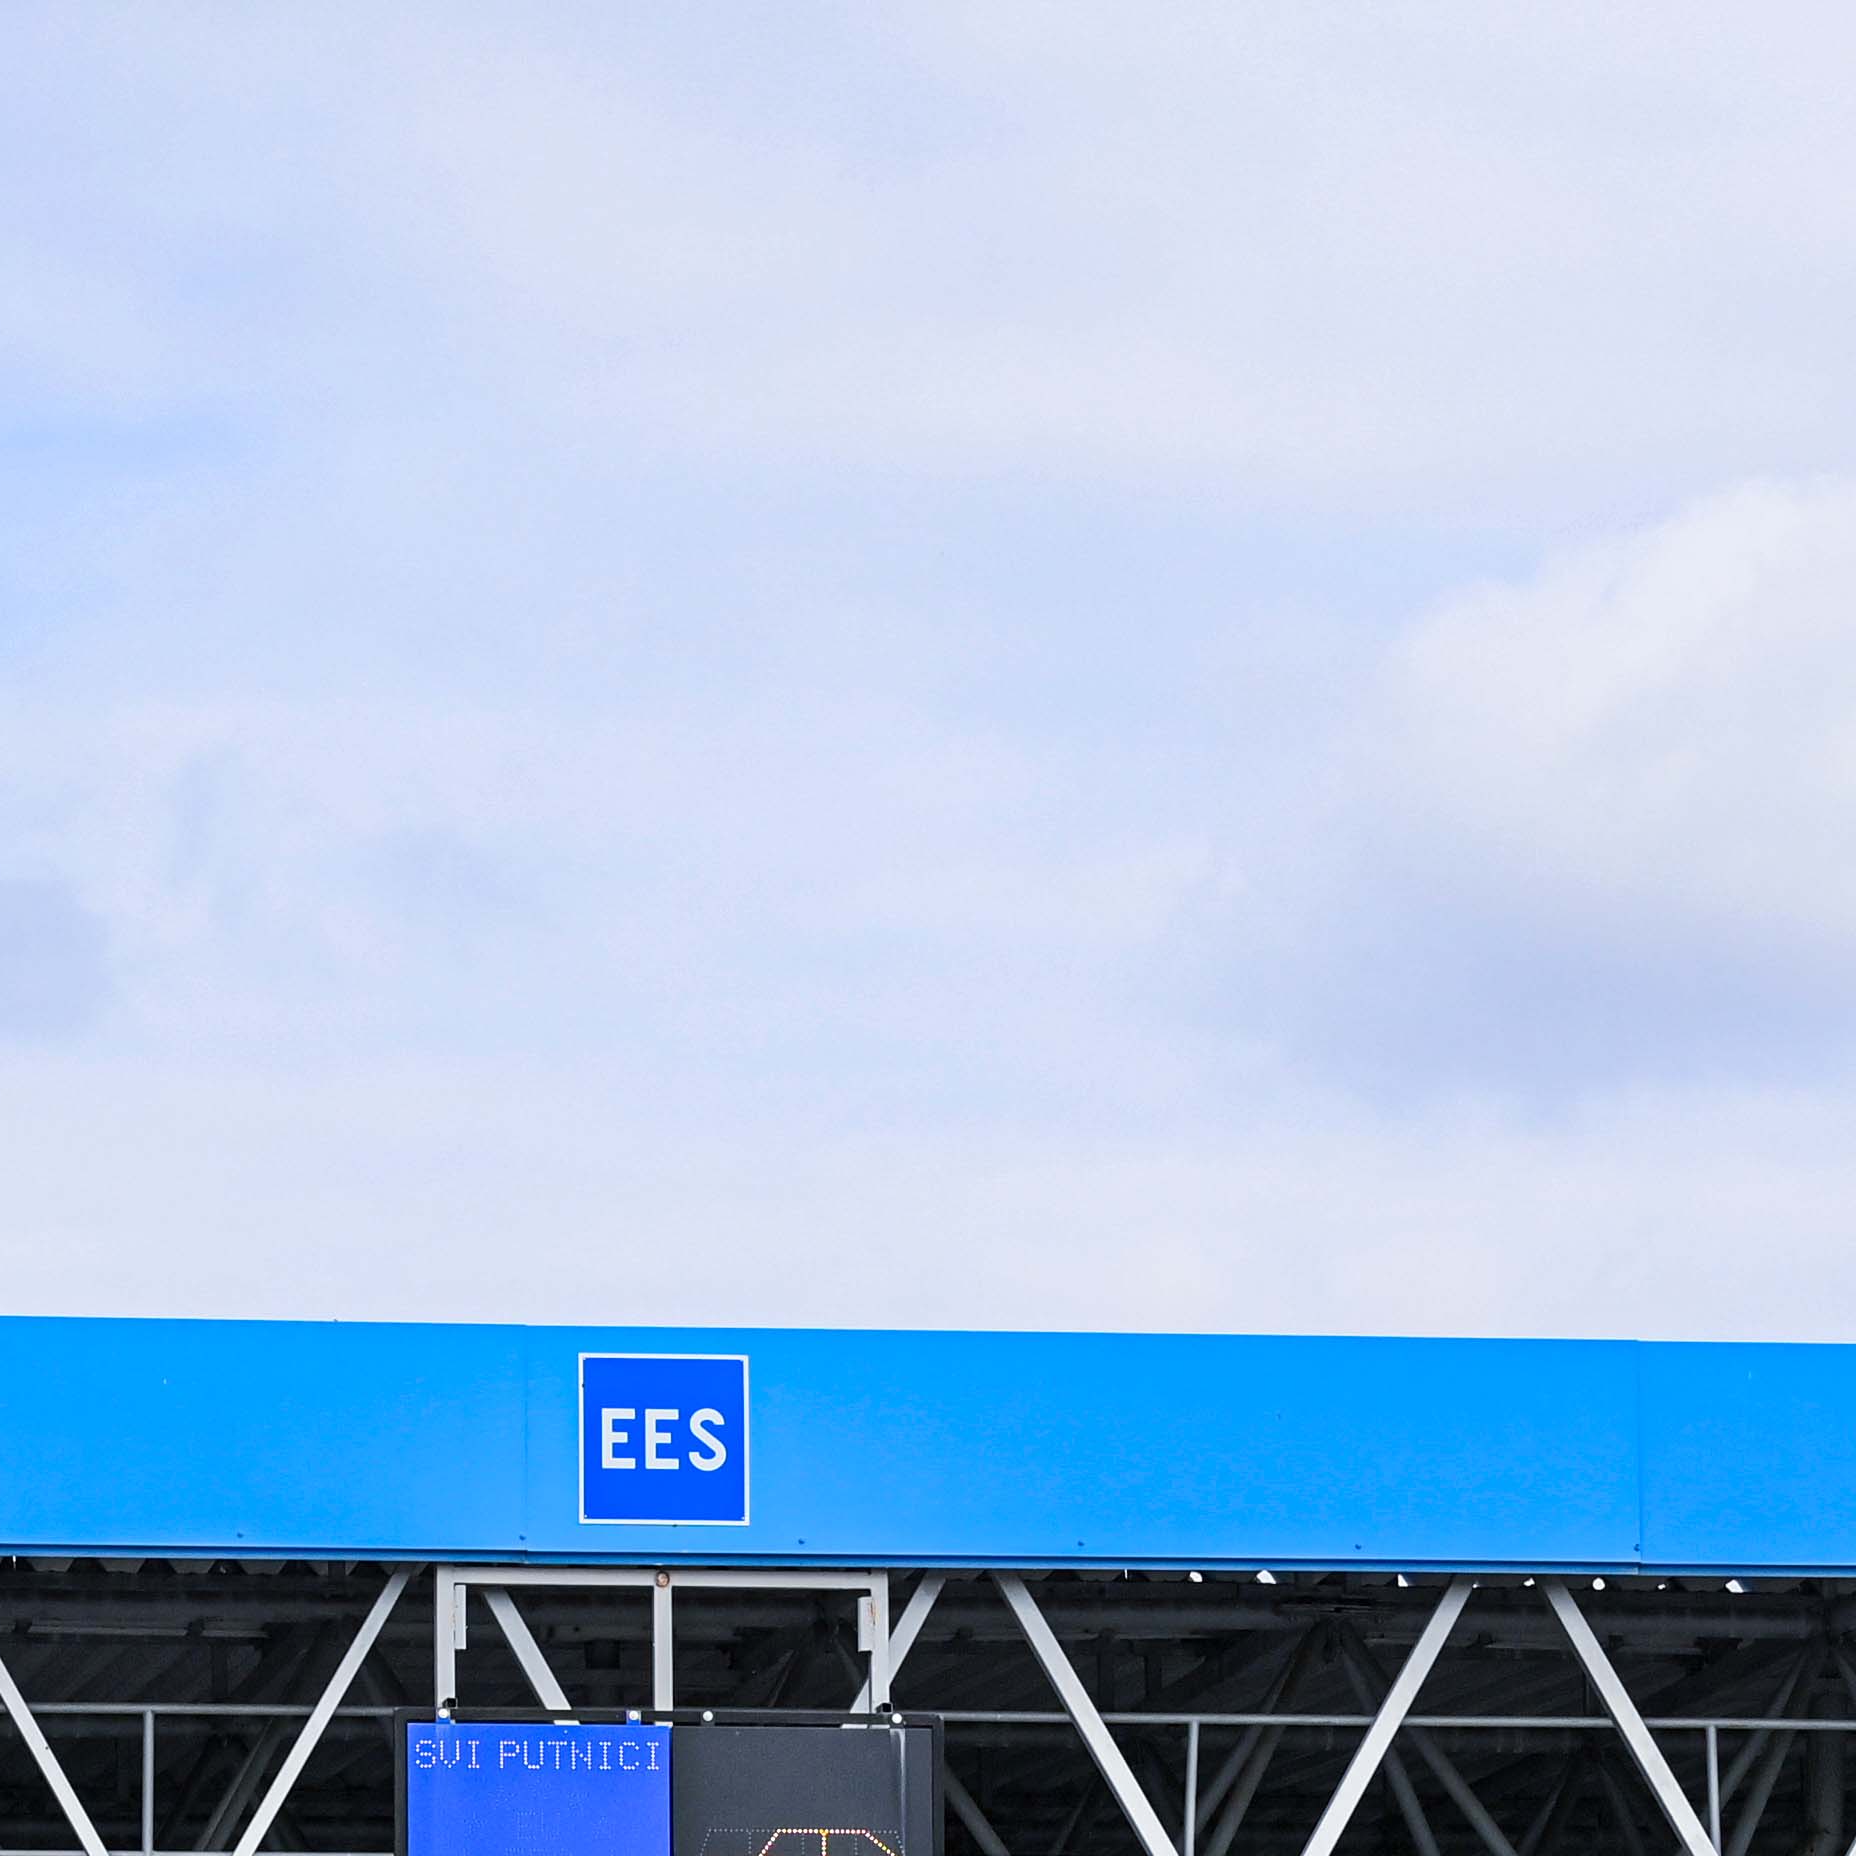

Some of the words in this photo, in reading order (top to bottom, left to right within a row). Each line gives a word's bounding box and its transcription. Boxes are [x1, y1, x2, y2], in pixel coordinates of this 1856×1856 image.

[601, 1407, 727, 1472] EES
[415, 1739, 480, 1769] SVI
[499, 1740, 660, 1771] PUTNICI
